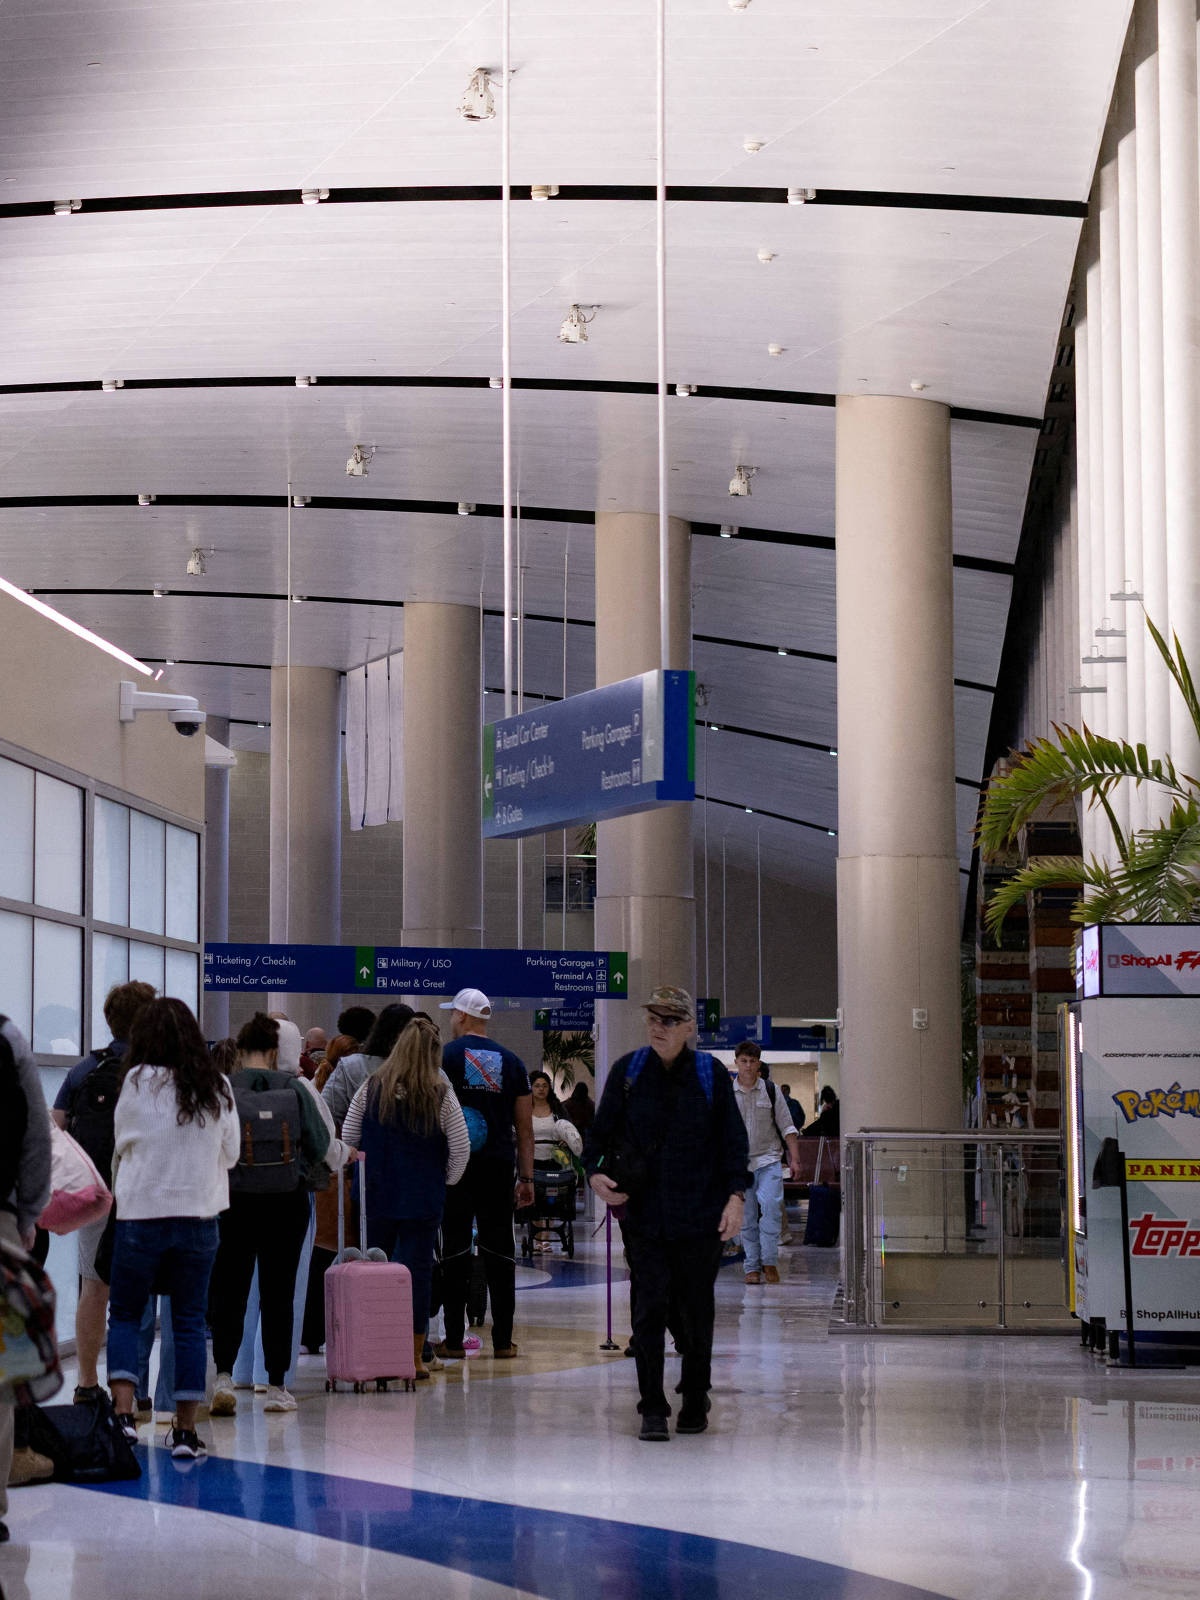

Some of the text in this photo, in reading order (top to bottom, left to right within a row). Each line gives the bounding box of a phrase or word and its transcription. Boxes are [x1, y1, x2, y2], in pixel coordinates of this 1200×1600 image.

[503, 721, 549, 750] Rental Car Center
[581, 723, 632, 752] Parking Garages
[502, 765, 526, 788] Ticketing
[531, 754, 555, 780] Check-In
[601, 770, 631, 790] Restrooms
[507, 804, 523, 824] Gates
[215, 954, 297, 967] Ticketing / Check-In
[390, 958, 452, 970] Military / USO
[526, 956, 595, 969] Parking Garages
[1120, 954, 1172, 968] ShopAll
[215, 974, 288, 985] Rental Car Center
[551, 971, 593, 980] Terminal A
[390, 979, 446, 988] Meet & Greet
[554, 982, 594, 992] Restrooms
